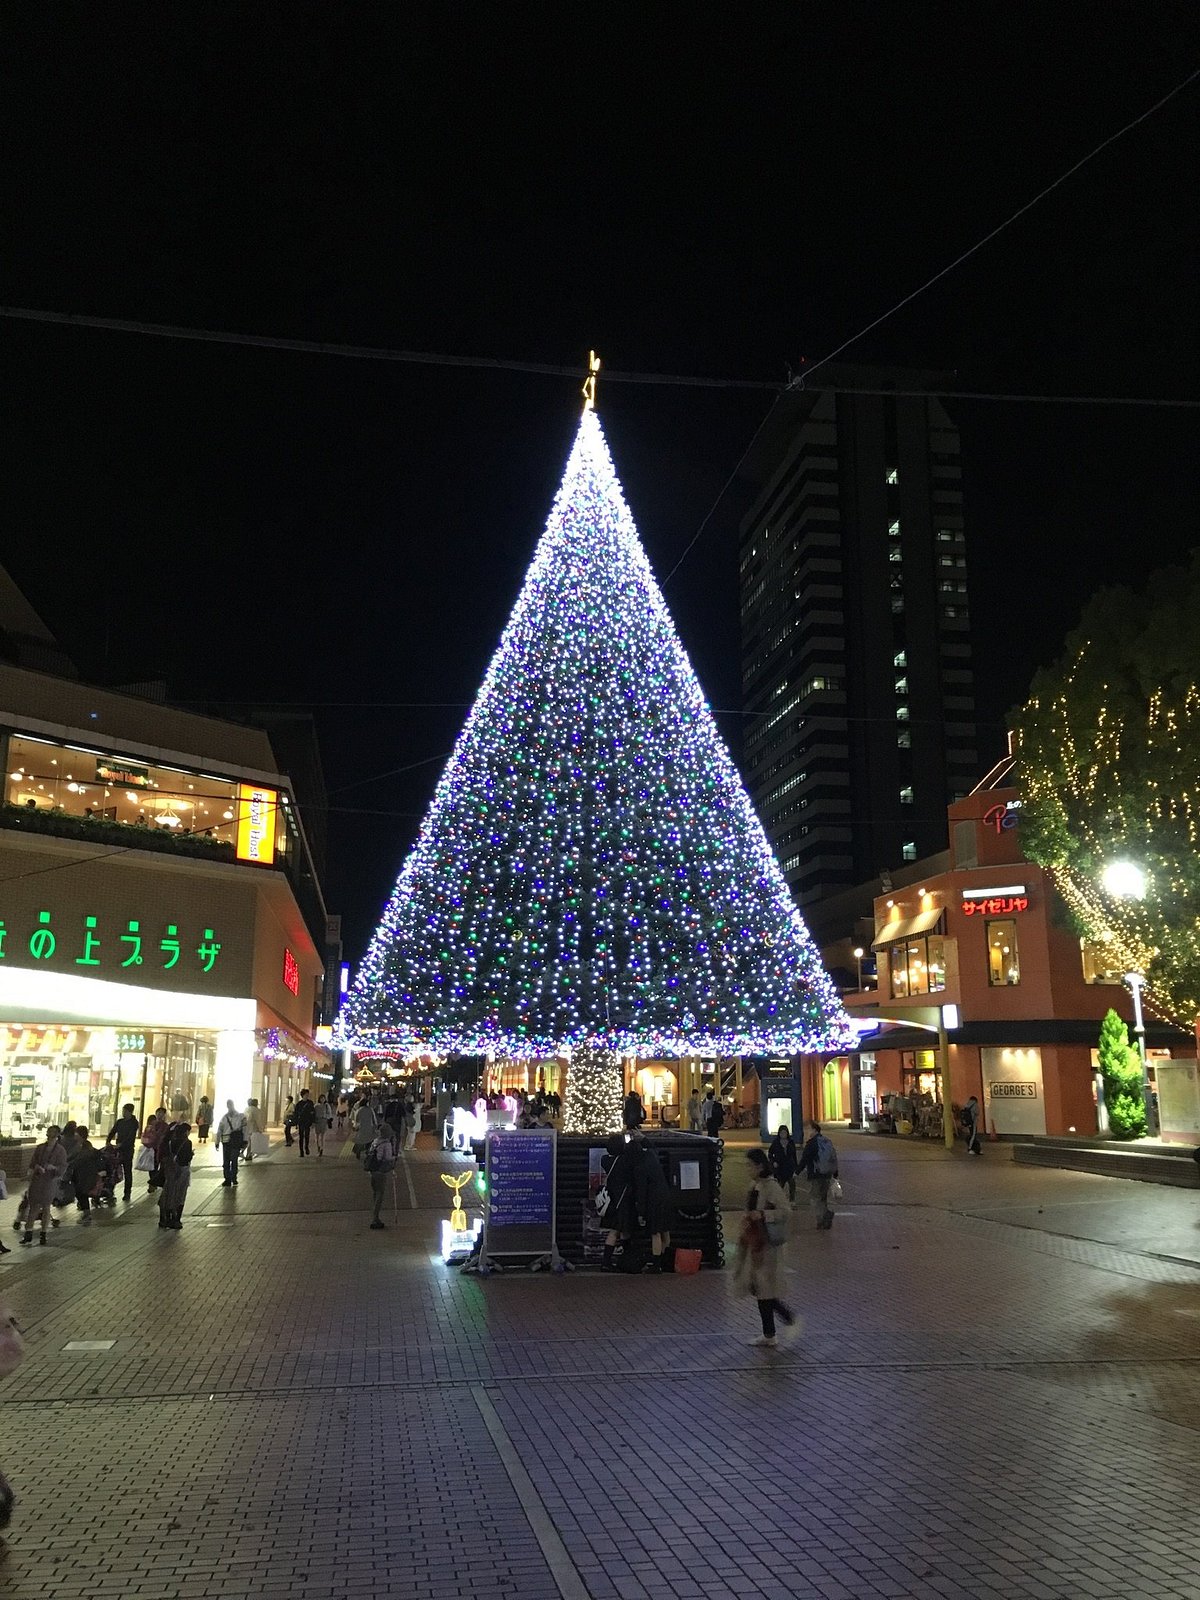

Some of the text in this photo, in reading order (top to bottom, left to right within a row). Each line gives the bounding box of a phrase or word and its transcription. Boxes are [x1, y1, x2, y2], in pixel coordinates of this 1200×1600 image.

[250, 793, 263, 857] Royal Host
[962, 897, 1028, 916] サイゼリヤ
[0, 928, 221, 972] の上プラザ
[993, 1085, 1034, 1096] GEORGE'S
